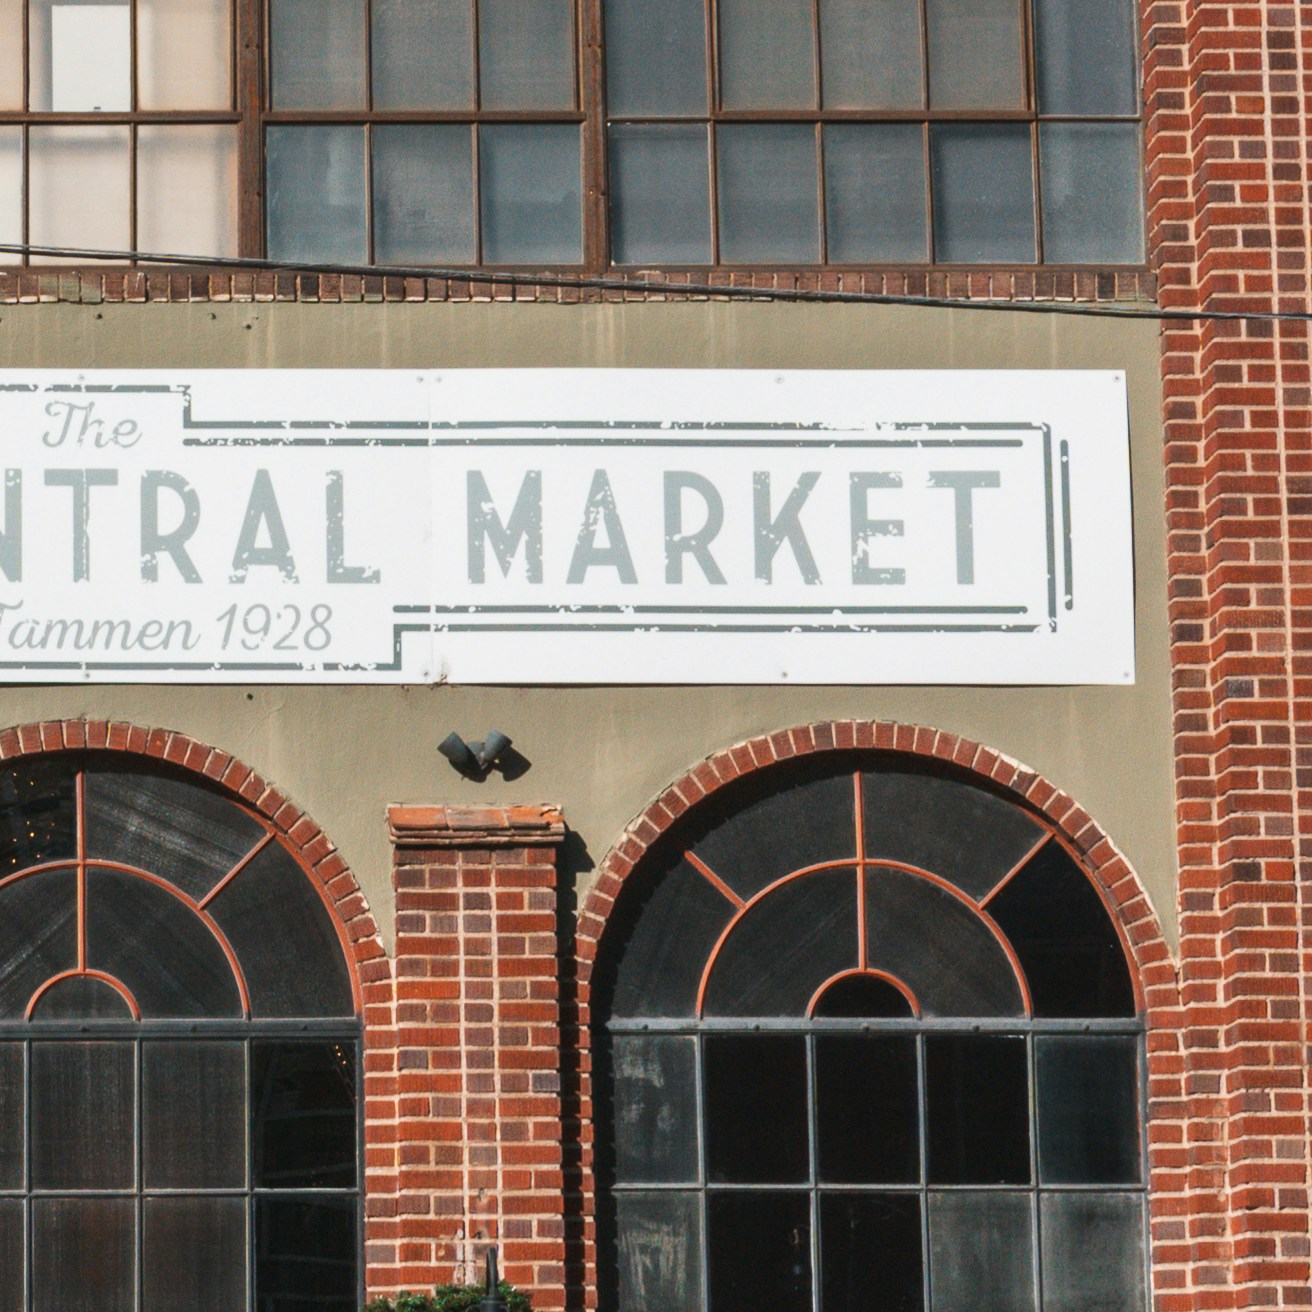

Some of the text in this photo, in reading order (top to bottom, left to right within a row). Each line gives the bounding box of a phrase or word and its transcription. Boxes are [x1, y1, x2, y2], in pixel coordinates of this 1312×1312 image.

[41, 399, 143, 450] The
[466, 468, 1001, 586] MARKET
[215, 602, 333, 652] 1928
